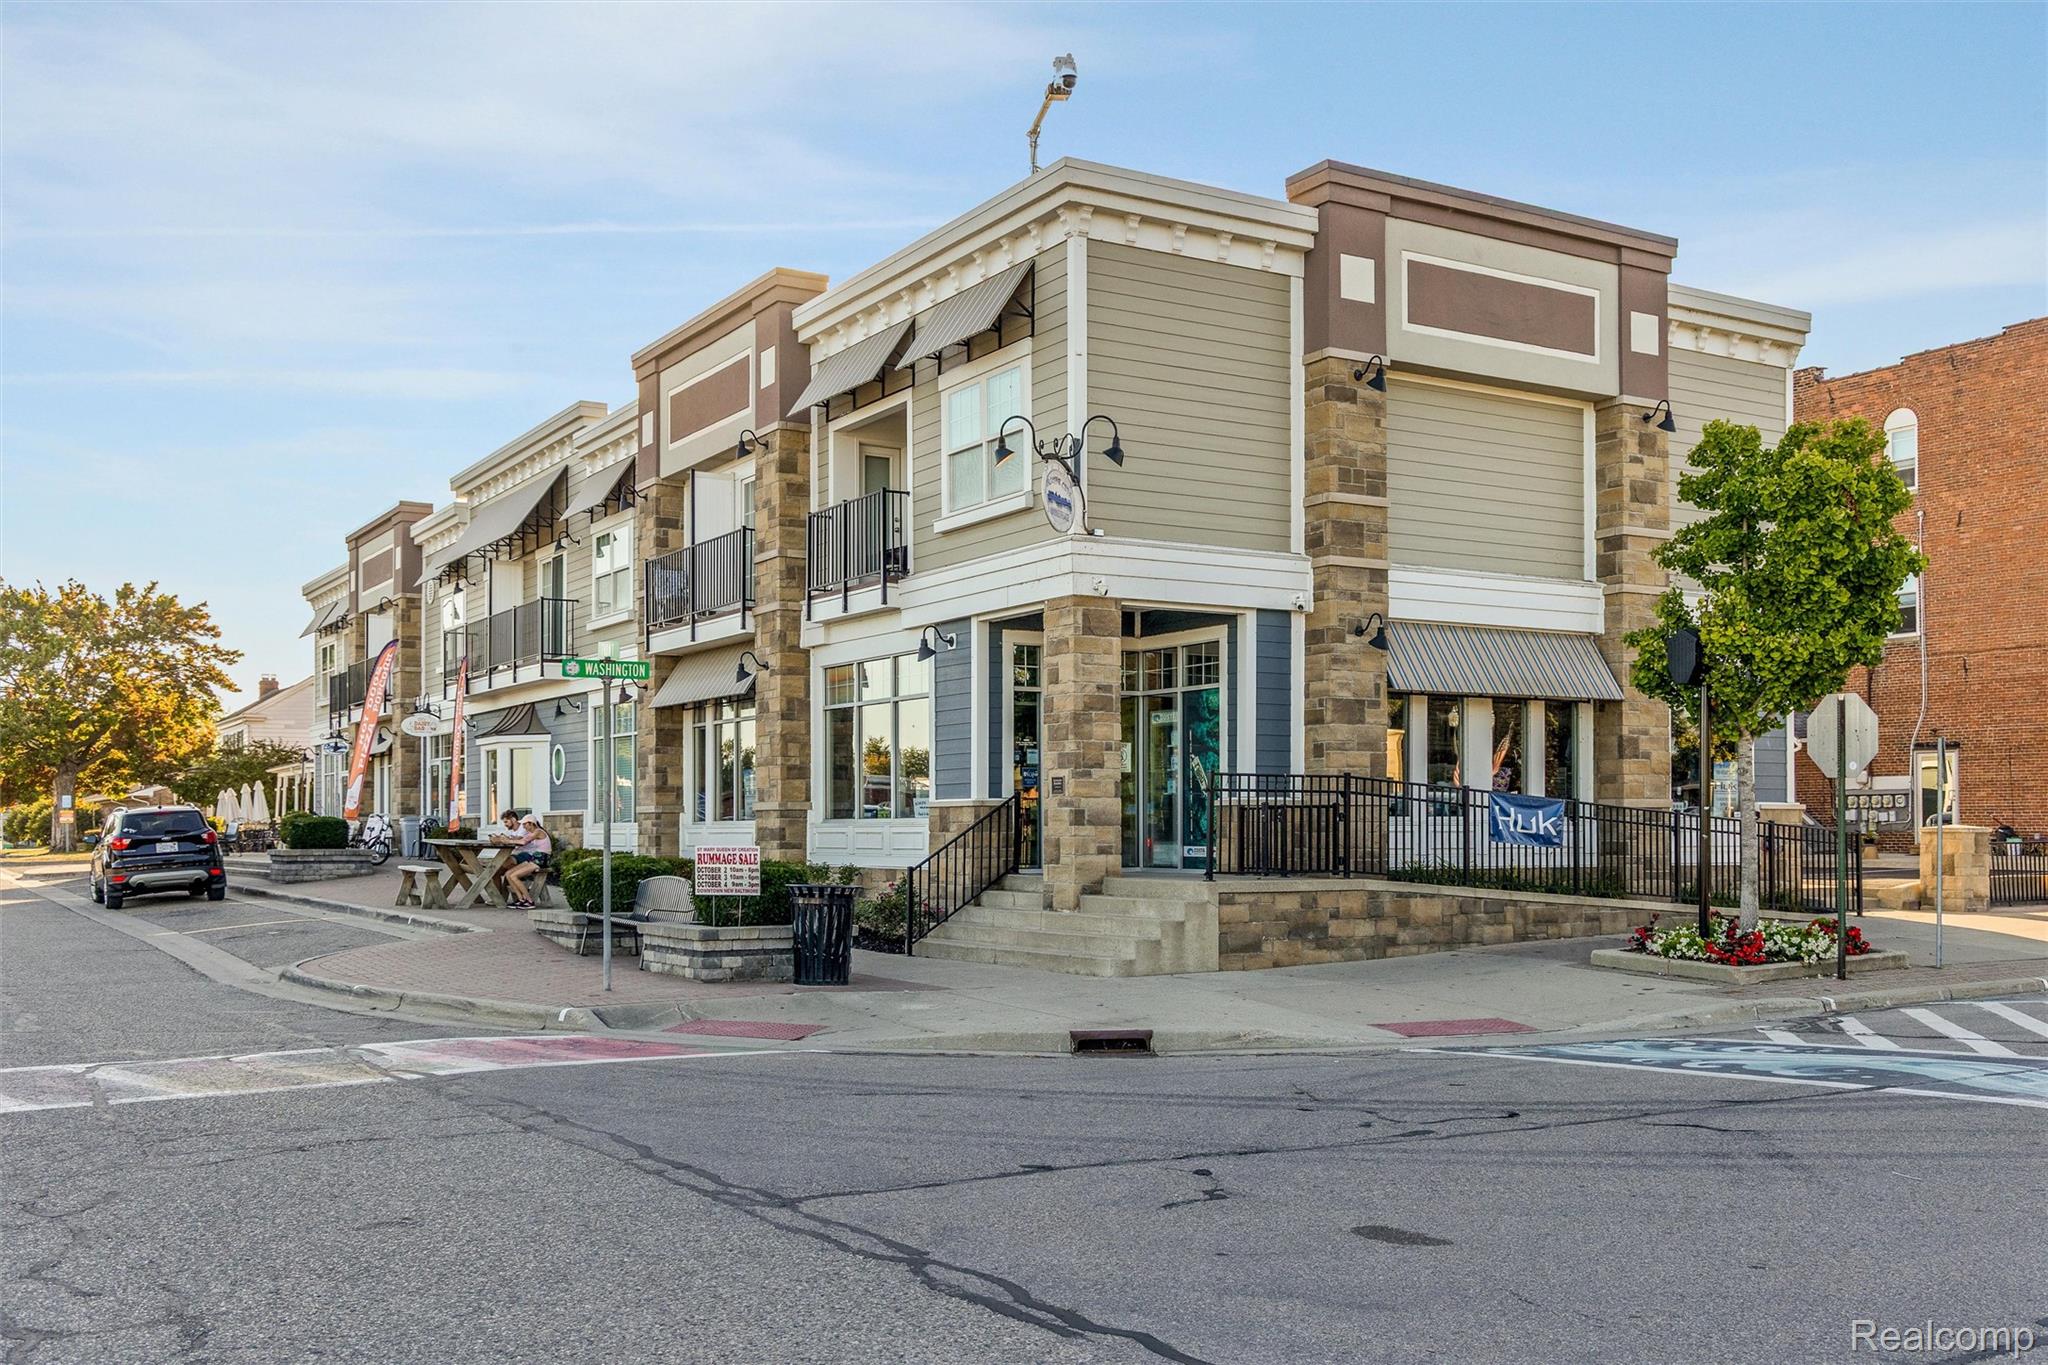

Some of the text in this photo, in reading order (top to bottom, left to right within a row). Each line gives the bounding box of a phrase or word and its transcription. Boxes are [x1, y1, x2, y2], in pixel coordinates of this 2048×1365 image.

[585, 662, 646, 677] WASHINGTON
[697, 853, 758, 865] RUMMAGE SALE
